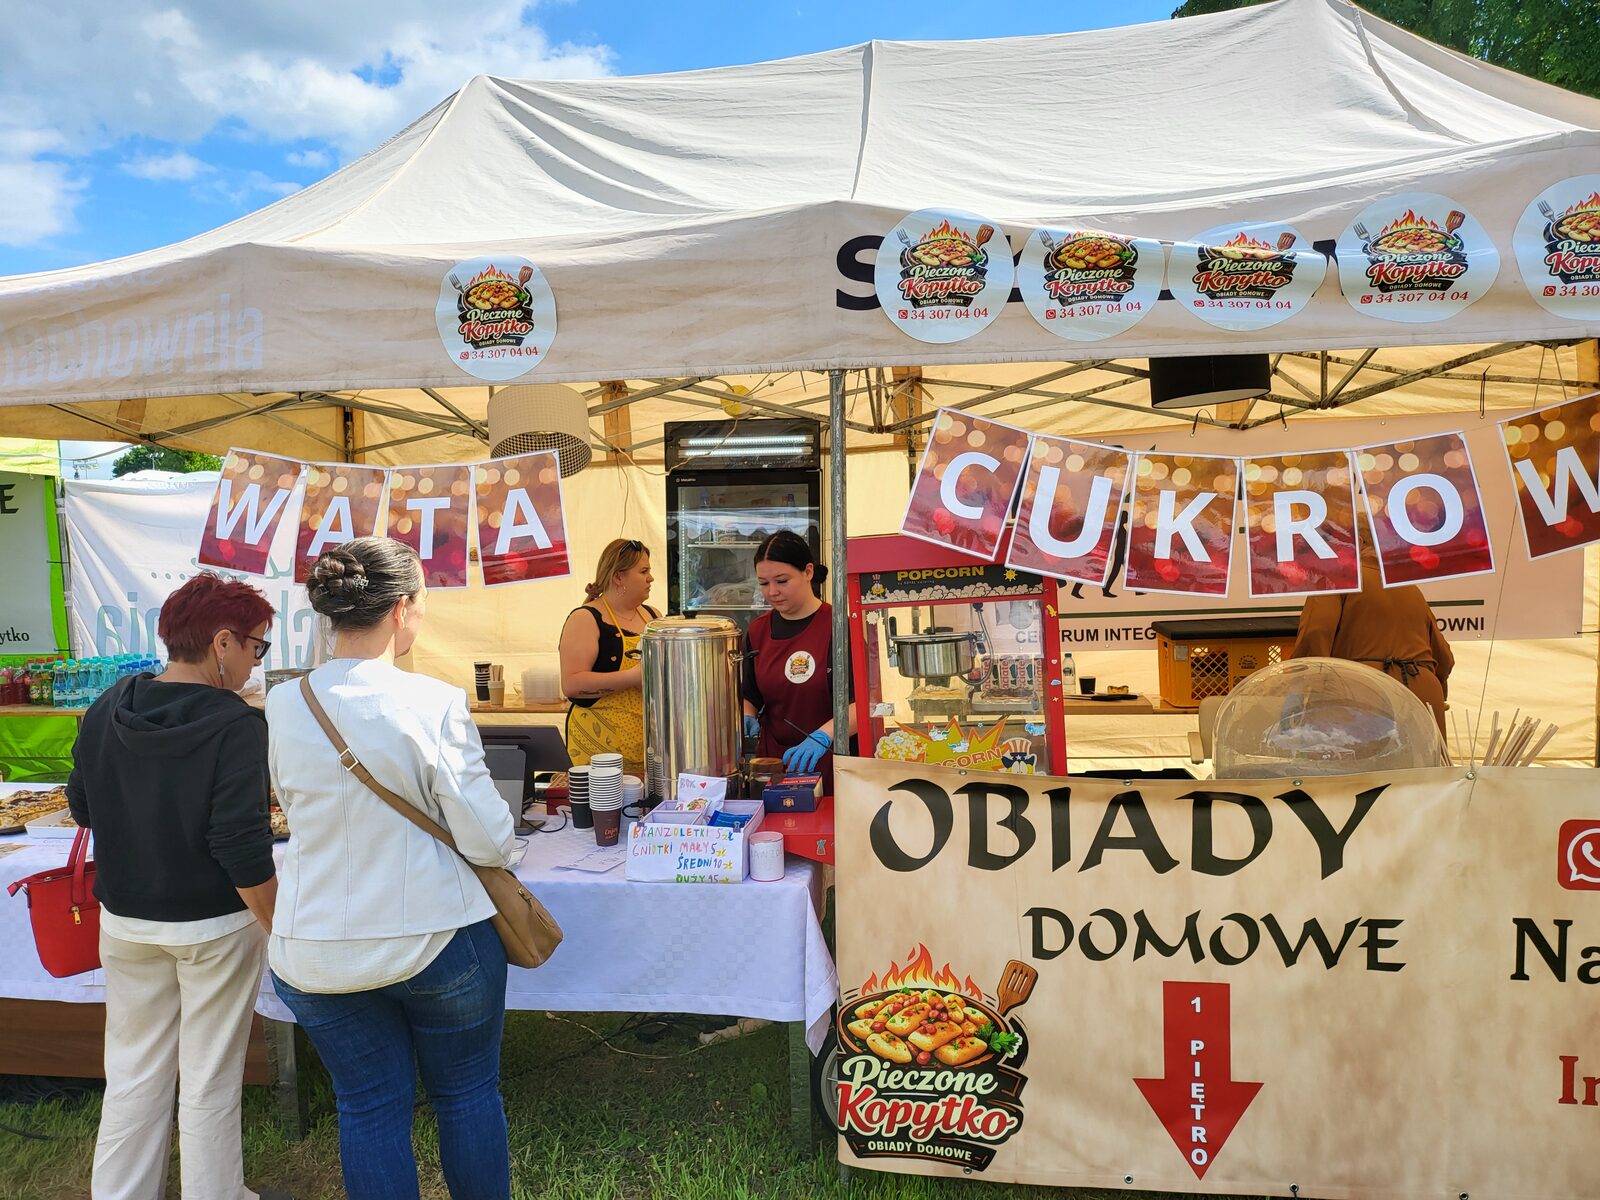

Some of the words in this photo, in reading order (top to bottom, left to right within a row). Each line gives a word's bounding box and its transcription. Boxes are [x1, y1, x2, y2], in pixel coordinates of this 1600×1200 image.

[1557, 240, 1600, 254] Piecz
[1208, 258, 1284, 273] Pieczone
[1378, 253, 1454, 263] Pieczone
[1545, 251, 1600, 275] Kopy
[909, 265, 976, 279] Pieczone
[1055, 268, 1124, 283] Pieczone
[1367, 261, 1467, 286] Kopytko
[899, 277, 984, 299] Kopytko
[1045, 278, 1132, 297] Kopytko
[1194, 271, 1290, 293] Kopytko
[1376, 294, 1393, 303] 34
[1397, 293, 1424, 302] 307
[1429, 292, 1446, 301] 04
[1451, 291, 1469, 300] 04
[1559, 285, 1577, 296] 34
[1581, 285, 1600, 296] 30
[1059, 307, 1075, 318] 34
[1079, 305, 1102, 316] 307
[1106, 303, 1121, 313] 04
[1126, 302, 1141, 311] 04
[1276, 301, 1292, 309] 04
[467, 308, 523, 322] Pieczone
[911, 310, 925, 320] 34
[929, 309, 951, 319] 307
[955, 309, 970, 318] 04
[973, 307, 988, 318] 04
[460, 319, 533, 342] Kopytko
[472, 351, 484, 359] 34
[487, 349, 507, 358] 307
[510, 347, 523, 357] 04
[526, 346, 539, 356] 04
[0, 484, 19, 514] E
[215, 478, 553, 560] WATA
[939, 446, 1600, 563] CUKROW
[896, 565, 985, 581] POPCORN
[1435, 617, 1484, 631] OWNI
[0, 626, 30, 645] ytko
[1105, 627, 1157, 641] INTEG
[632, 826, 709, 839] BRANZOLETKI
[869, 778, 1391, 880] OBIADY
[711, 843, 717, 854] 5
[714, 858, 722, 869] 10
[676, 873, 705, 883] DUŻY
[708, 874, 719, 883] 15
[1022, 907, 1407, 972] DOMOWE
[1510, 917, 1600, 986] Na
[1190, 996, 1203, 1014] 1
[842, 1055, 998, 1095] Pieczone
[1190, 1039, 1208, 1167] PIĘTRO
[836, 1081, 1019, 1142] Kopytko
[867, 1140, 913, 1152] OBIADY
[917, 1143, 973, 1161] DOMOWE
